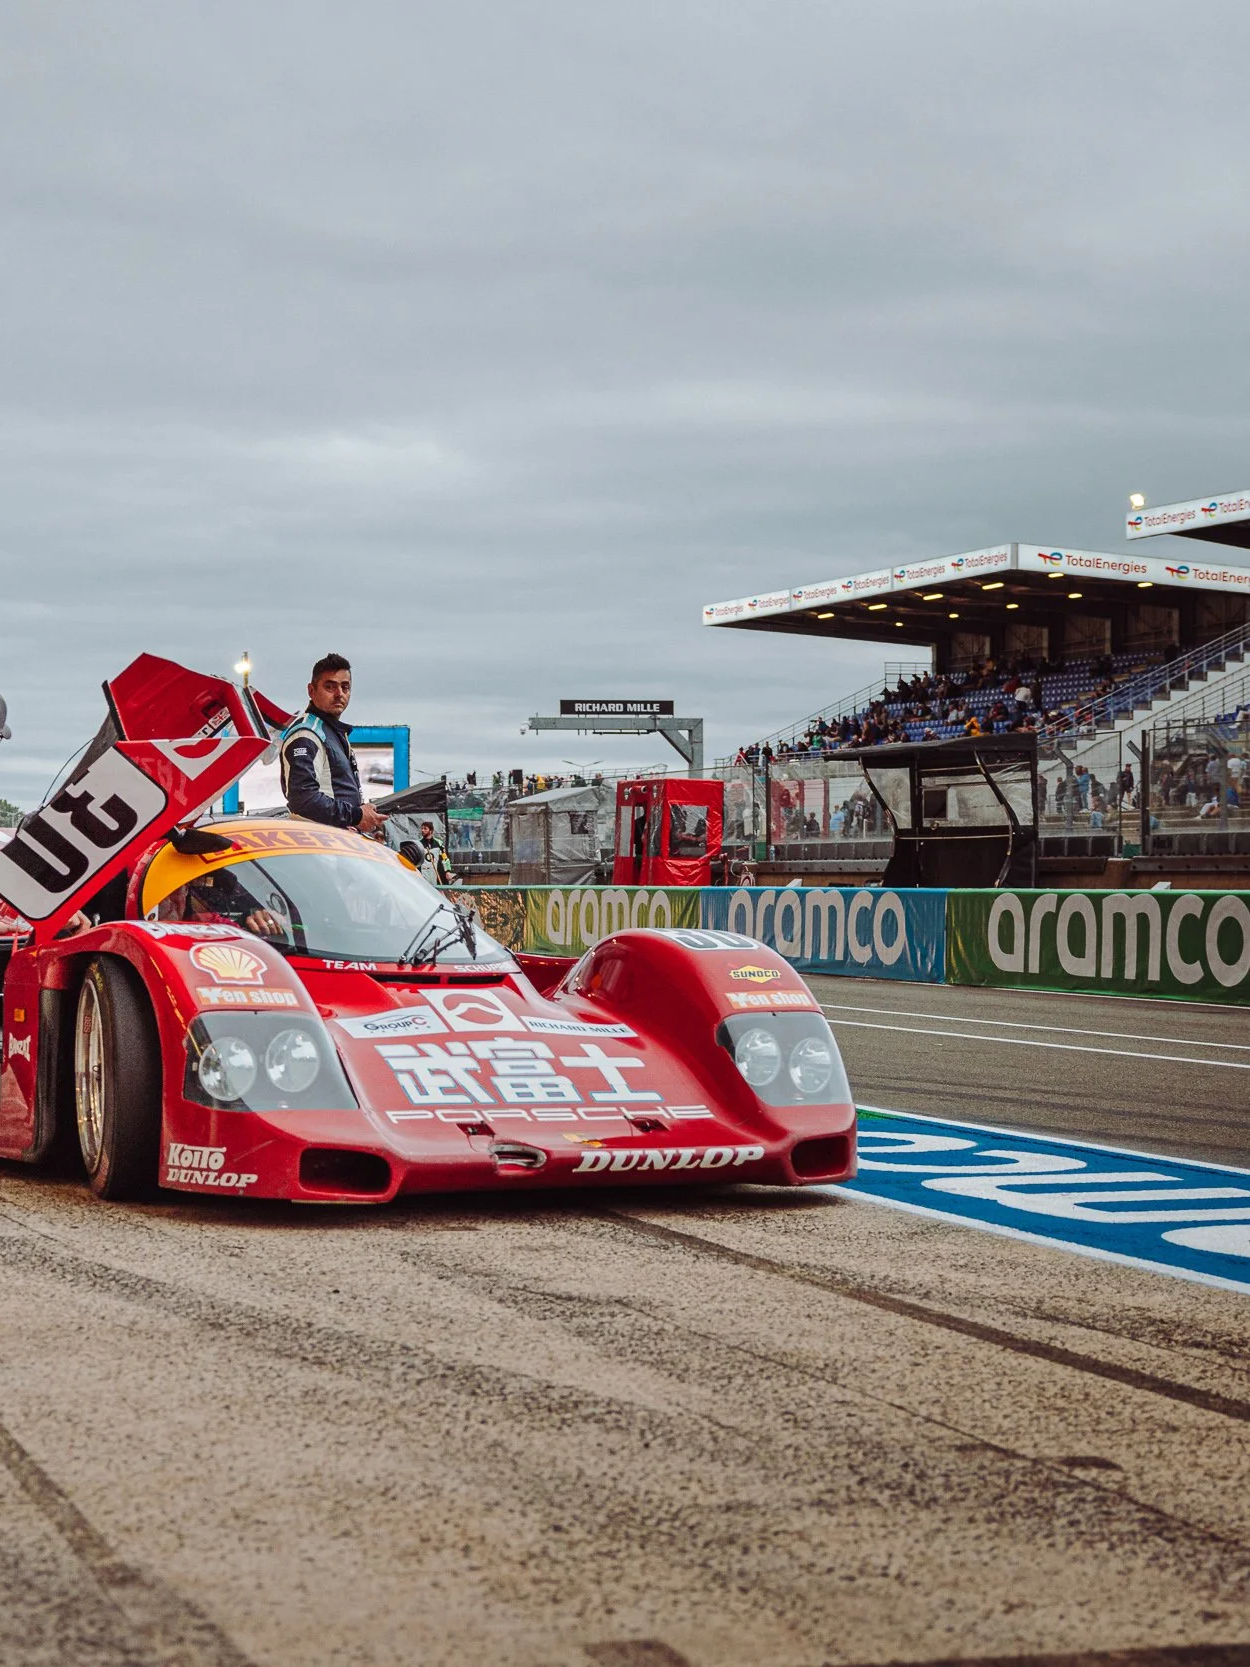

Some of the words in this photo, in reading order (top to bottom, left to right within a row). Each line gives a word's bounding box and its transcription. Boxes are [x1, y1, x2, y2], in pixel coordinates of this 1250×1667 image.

[1144, 509, 1196, 526] TotalEnergies
[1065, 554, 1147, 575] TotalEnergies
[714, 605, 744, 617] TotalEnergies
[758, 596, 790, 609] TotalEnergies
[803, 586, 838, 601] TotalEnergies
[853, 575, 890, 592] TotalEnergies
[906, 564, 946, 581] TotalEnergies
[965, 551, 1008, 570] TotalEnergies
[574, 702, 624, 713] RICHARD
[626, 702, 661, 713] MILLE
[548, 889, 672, 944] aramco
[728, 889, 906, 966] aramco
[988, 891, 1250, 988] aramco
[322, 960, 377, 972] TEAM
[733, 970, 779, 978] SUNOCO
[249, 989, 298, 1007] shop
[770, 991, 812, 1006] shop
[528, 1020, 587, 1032] RICHARD
[589, 1026, 630, 1034] MILLE
[374, 1037, 665, 1104] 武富士
[385, 1105, 715, 1124] PORSCHE
[572, 1146, 765, 1173] DUNLOP
[167, 1168, 259, 1188] DUNLOP
